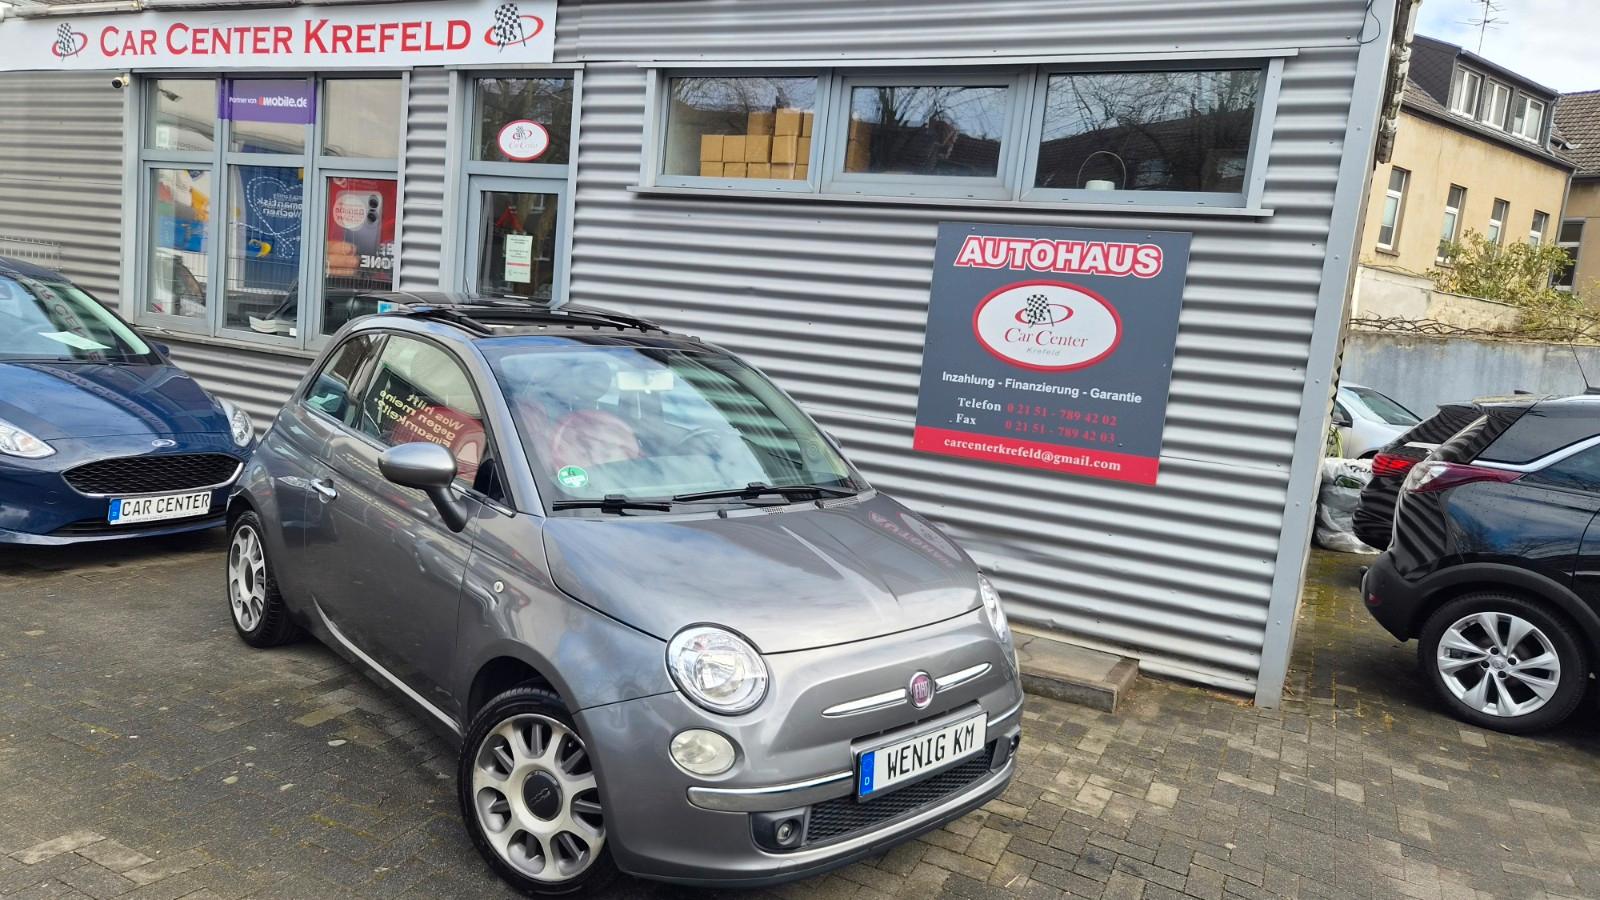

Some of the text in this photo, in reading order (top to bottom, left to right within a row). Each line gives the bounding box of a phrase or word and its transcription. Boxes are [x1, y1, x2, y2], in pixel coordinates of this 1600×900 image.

[100, 18, 472, 57] CAR CENTER KREFELD
[953, 235, 1163, 279] AUTOHAUS
[1004, 327, 1088, 348] Car Center
[1026, 346, 1061, 357] Krefeld
[942, 371, 995, 389] Inzahlung
[1005, 378, 1080, 399] Finanzierung
[1090, 387, 1142, 404] Garantie
[958, 397, 1001, 412] Telefon
[1007, 403, 1014, 414] 0
[1016, 404, 1030, 415] 21
[1034, 406, 1047, 417] 51
[1061, 409, 1081, 421] 789
[1084, 412, 1098, 424] 42
[1102, 415, 1117, 426] 02
[955, 413, 977, 425] Fax
[1004, 419, 1012, 431] 0
[1015, 421, 1028, 432] 21
[1032, 423, 1045, 434] 51
[1058, 425, 1079, 438] 789
[1082, 428, 1096, 440] 42
[1100, 432, 1116, 444] 03
[943, 437, 1122, 472] carcenterkrefeld@gmail.com
[122, 500, 152, 516] CAR
[156, 493, 209, 512] CENTER
[888, 722, 975, 780] WENIG KM
[864, 776, 871, 785] D
